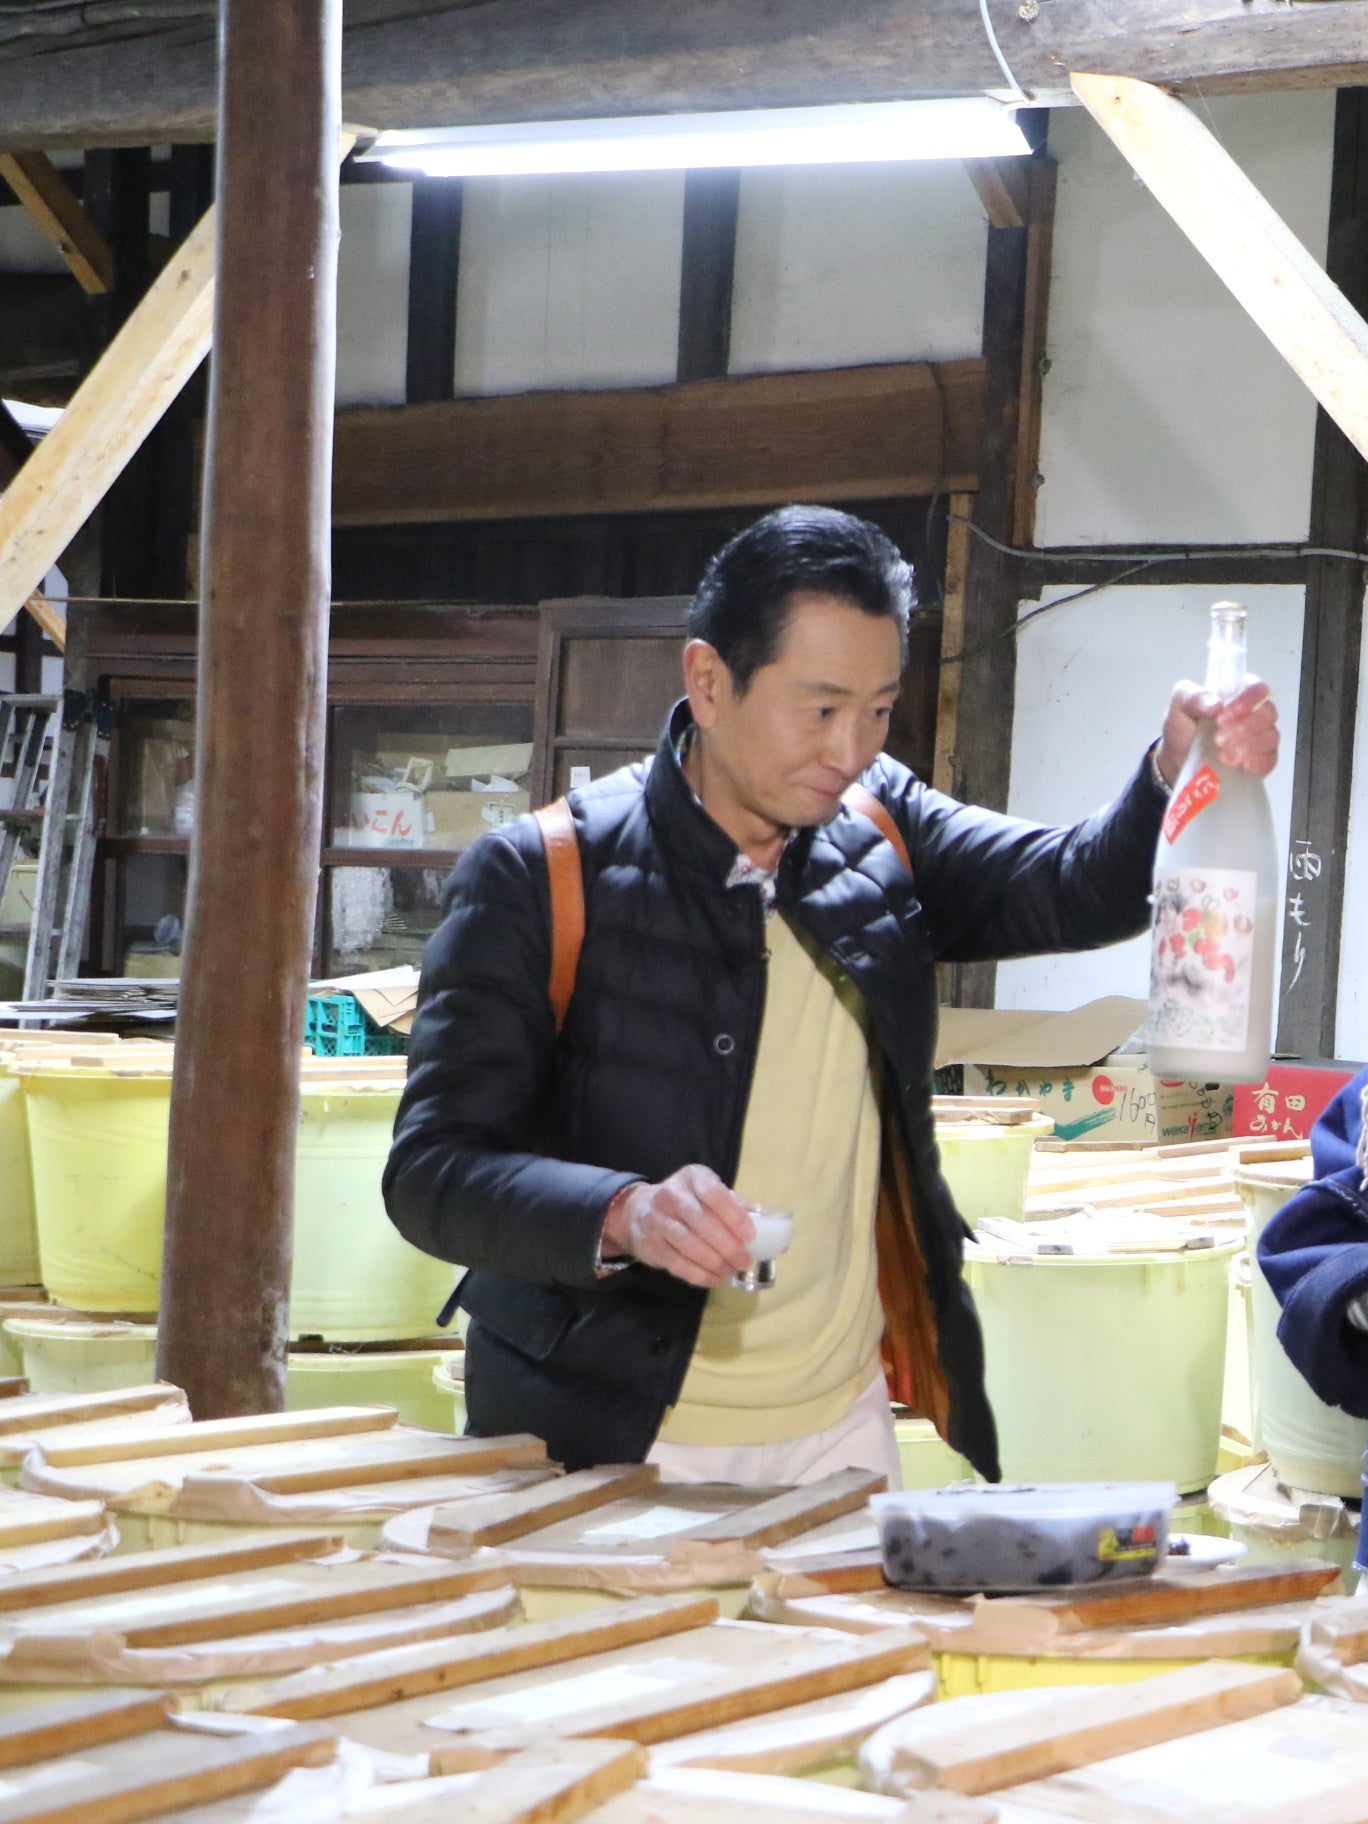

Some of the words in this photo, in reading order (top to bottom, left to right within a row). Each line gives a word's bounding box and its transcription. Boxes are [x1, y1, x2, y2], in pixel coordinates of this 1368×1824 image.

[1287, 840, 1322, 994] 雨もり
[984, 1069, 1076, 1102] わかやま
[1252, 1081, 1306, 1114] 有田
[1249, 1115, 1304, 1140] みかん
